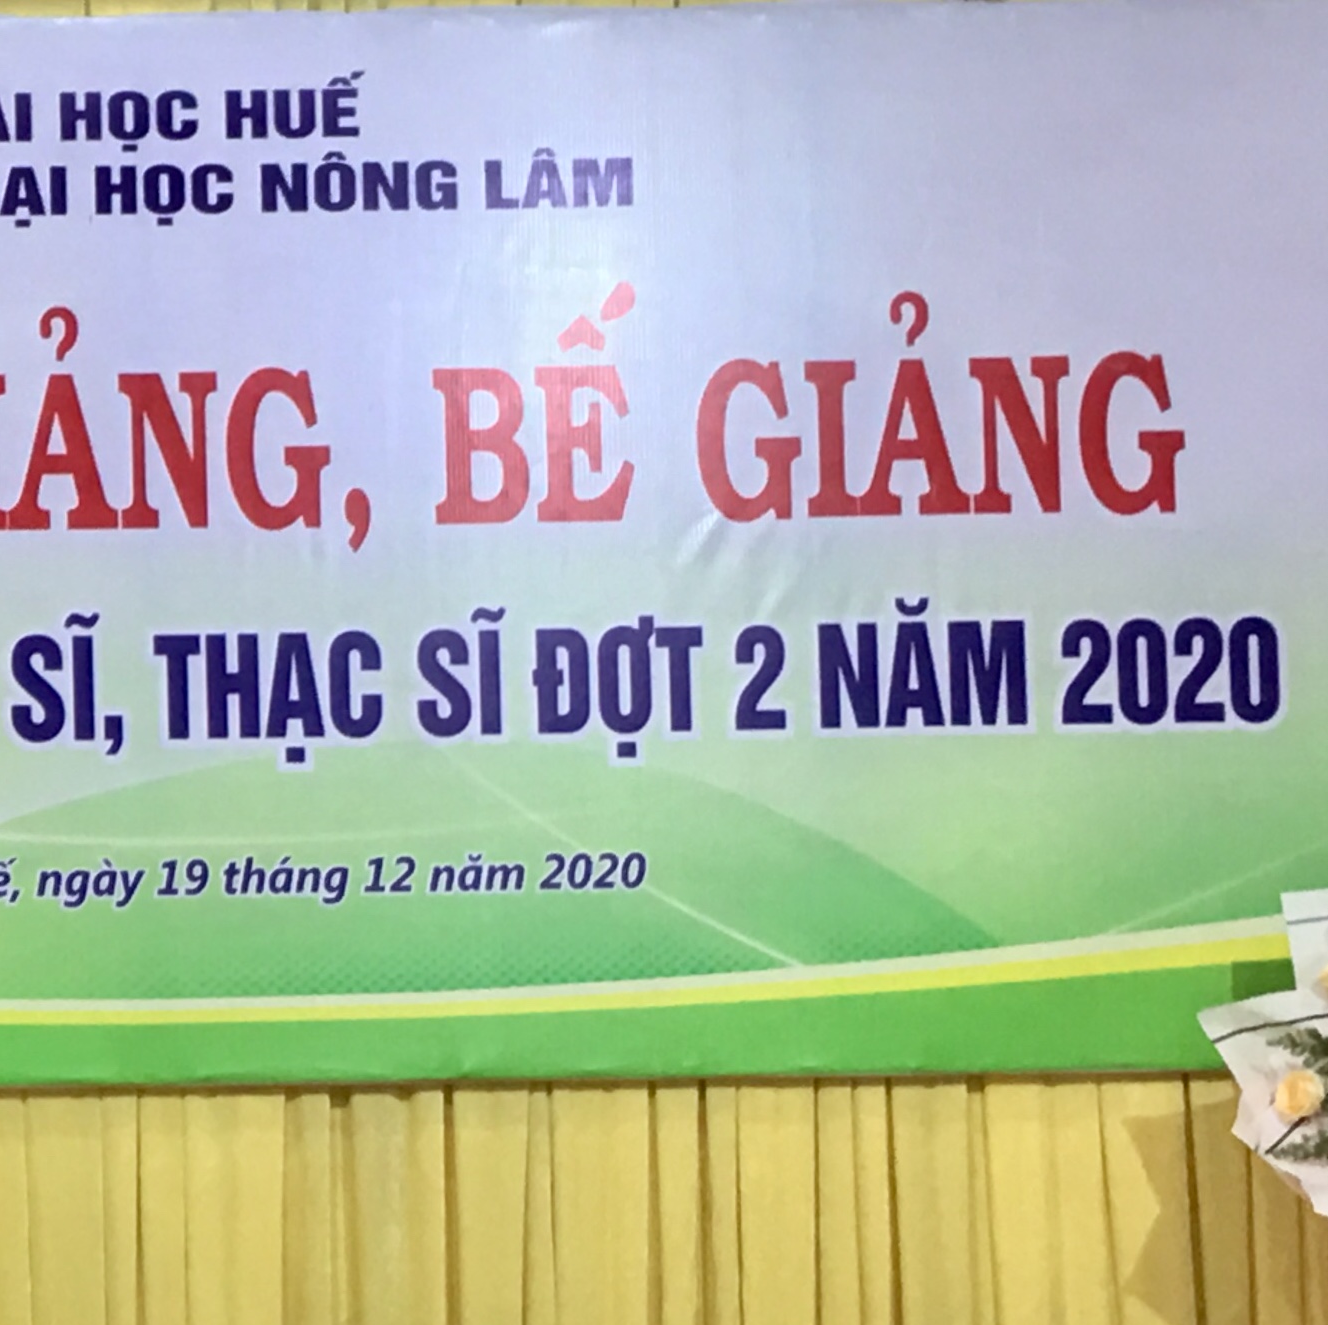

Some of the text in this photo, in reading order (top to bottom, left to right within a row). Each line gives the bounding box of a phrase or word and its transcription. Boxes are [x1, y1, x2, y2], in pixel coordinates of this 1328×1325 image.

[59, 89, 199, 154] HỌC
[224, 70, 365, 140] HUẾ
[94, 163, 235, 227] HỌC
[259, 149, 458, 213] NÔNG
[484, 149, 637, 208] LÂM
[431, 281, 637, 526] BẾ
[695, 290, 1186, 522] GIẢNG
[10, 612, 125, 757] SĨ,
[152, 629, 384, 764] THẠC
[417, 607, 506, 739] SĨ
[532, 615, 703, 759] ĐỢT
[734, 624, 788, 732] 2
[817, 597, 1030, 730] NĂM
[1059, 615, 1282, 726] 2020
[37, 860, 145, 907] ngày
[157, 859, 210, 895] 19
[223, 856, 349, 903] tháng
[364, 856, 416, 892] 12
[429, 854, 526, 892] năm
[539, 852, 647, 890] 2020
